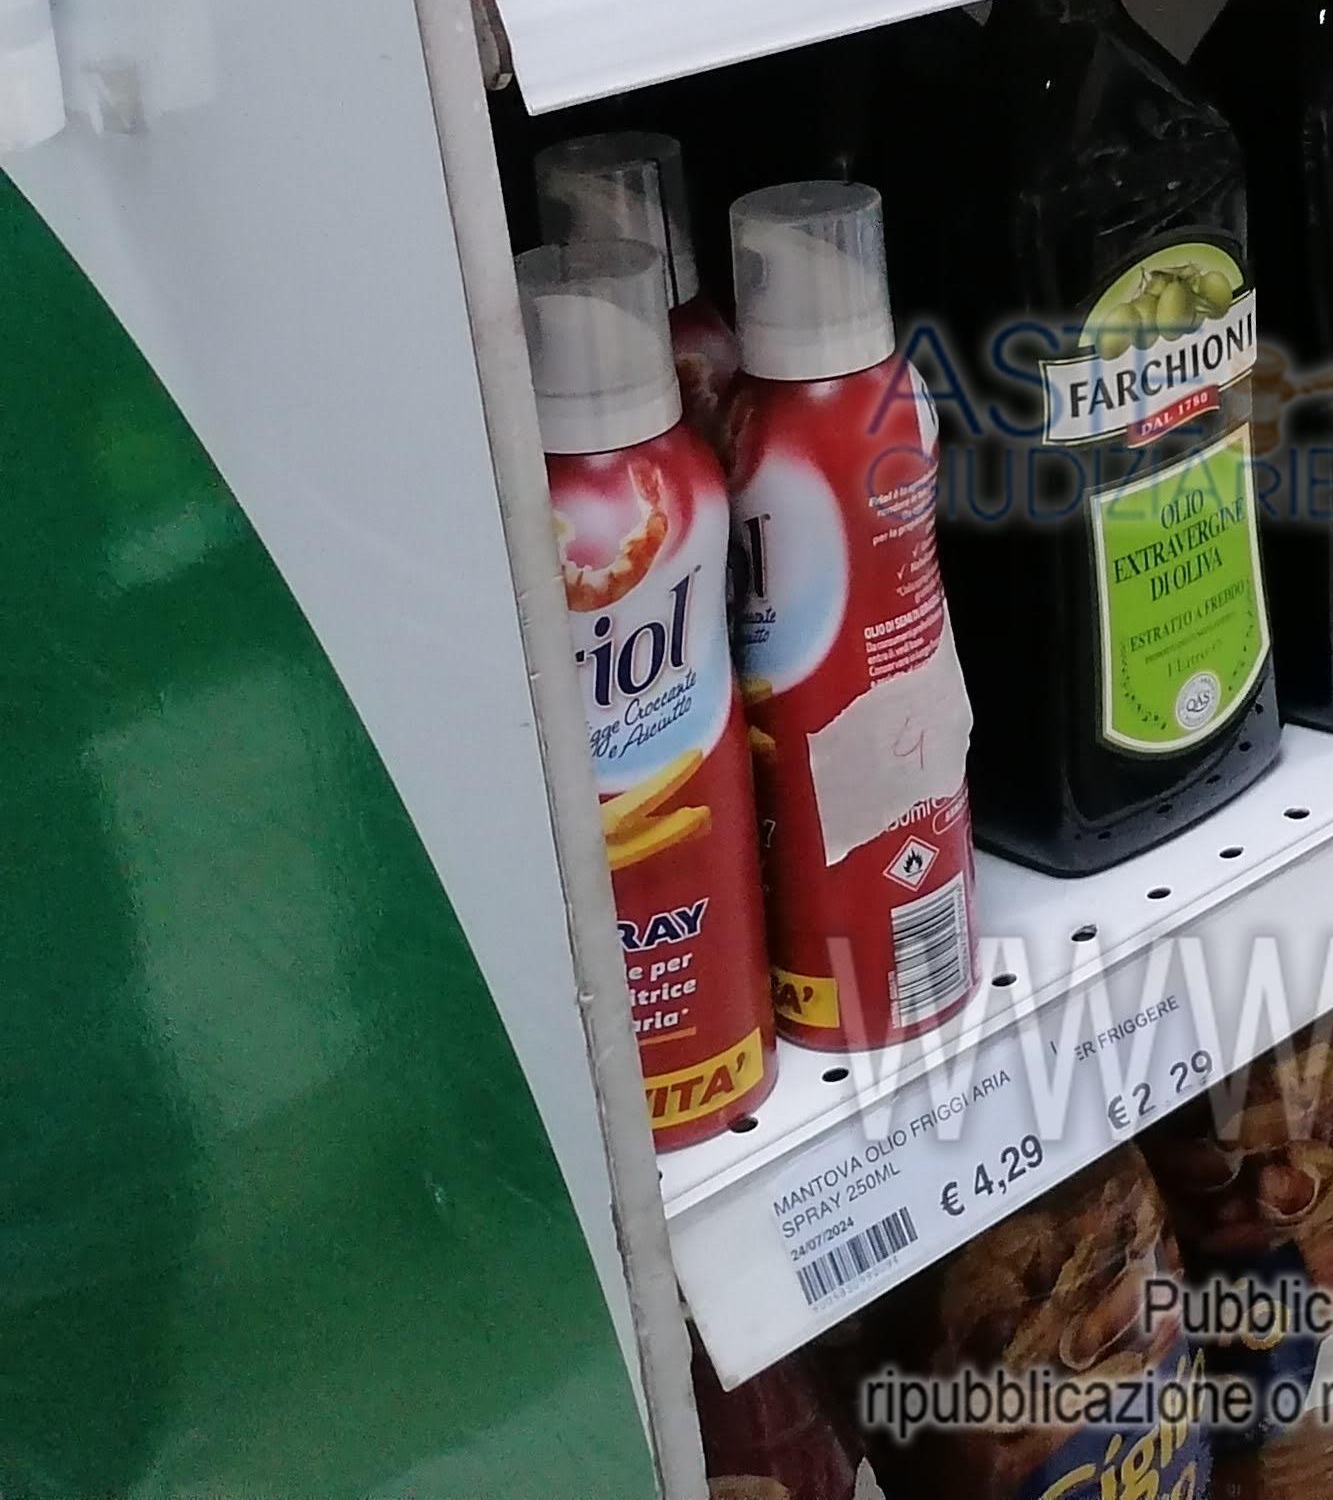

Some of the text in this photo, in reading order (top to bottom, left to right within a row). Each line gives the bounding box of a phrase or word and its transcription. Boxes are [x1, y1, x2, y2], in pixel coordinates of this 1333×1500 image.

[1069, 310, 1256, 420] FARCHIONI
[1140, 411, 1174, 437] DAL
[1160, 489, 1206, 531] OLIO
[1112, 495, 1247, 585] EXTRAVERGINE
[1149, 552, 1225, 603] DI OLIVA
[1129, 612, 1194, 654] ESTRATTO
[1203, 582, 1247, 617] FREDDO
[624, 667, 698, 727] Croccante
[1185, 688, 1213, 714] QAS
[652, 952, 694, 987] per
[1097, 994, 1181, 1047] FRIGGERE
[771, 1068, 1012, 1218] MANTOVA OLIO ARIA
[973, 1132, 1046, 1198] 4,29
[781, 1164, 902, 1240] SPRAY 250ML
[789, 1215, 856, 1262] 24/07/2024
